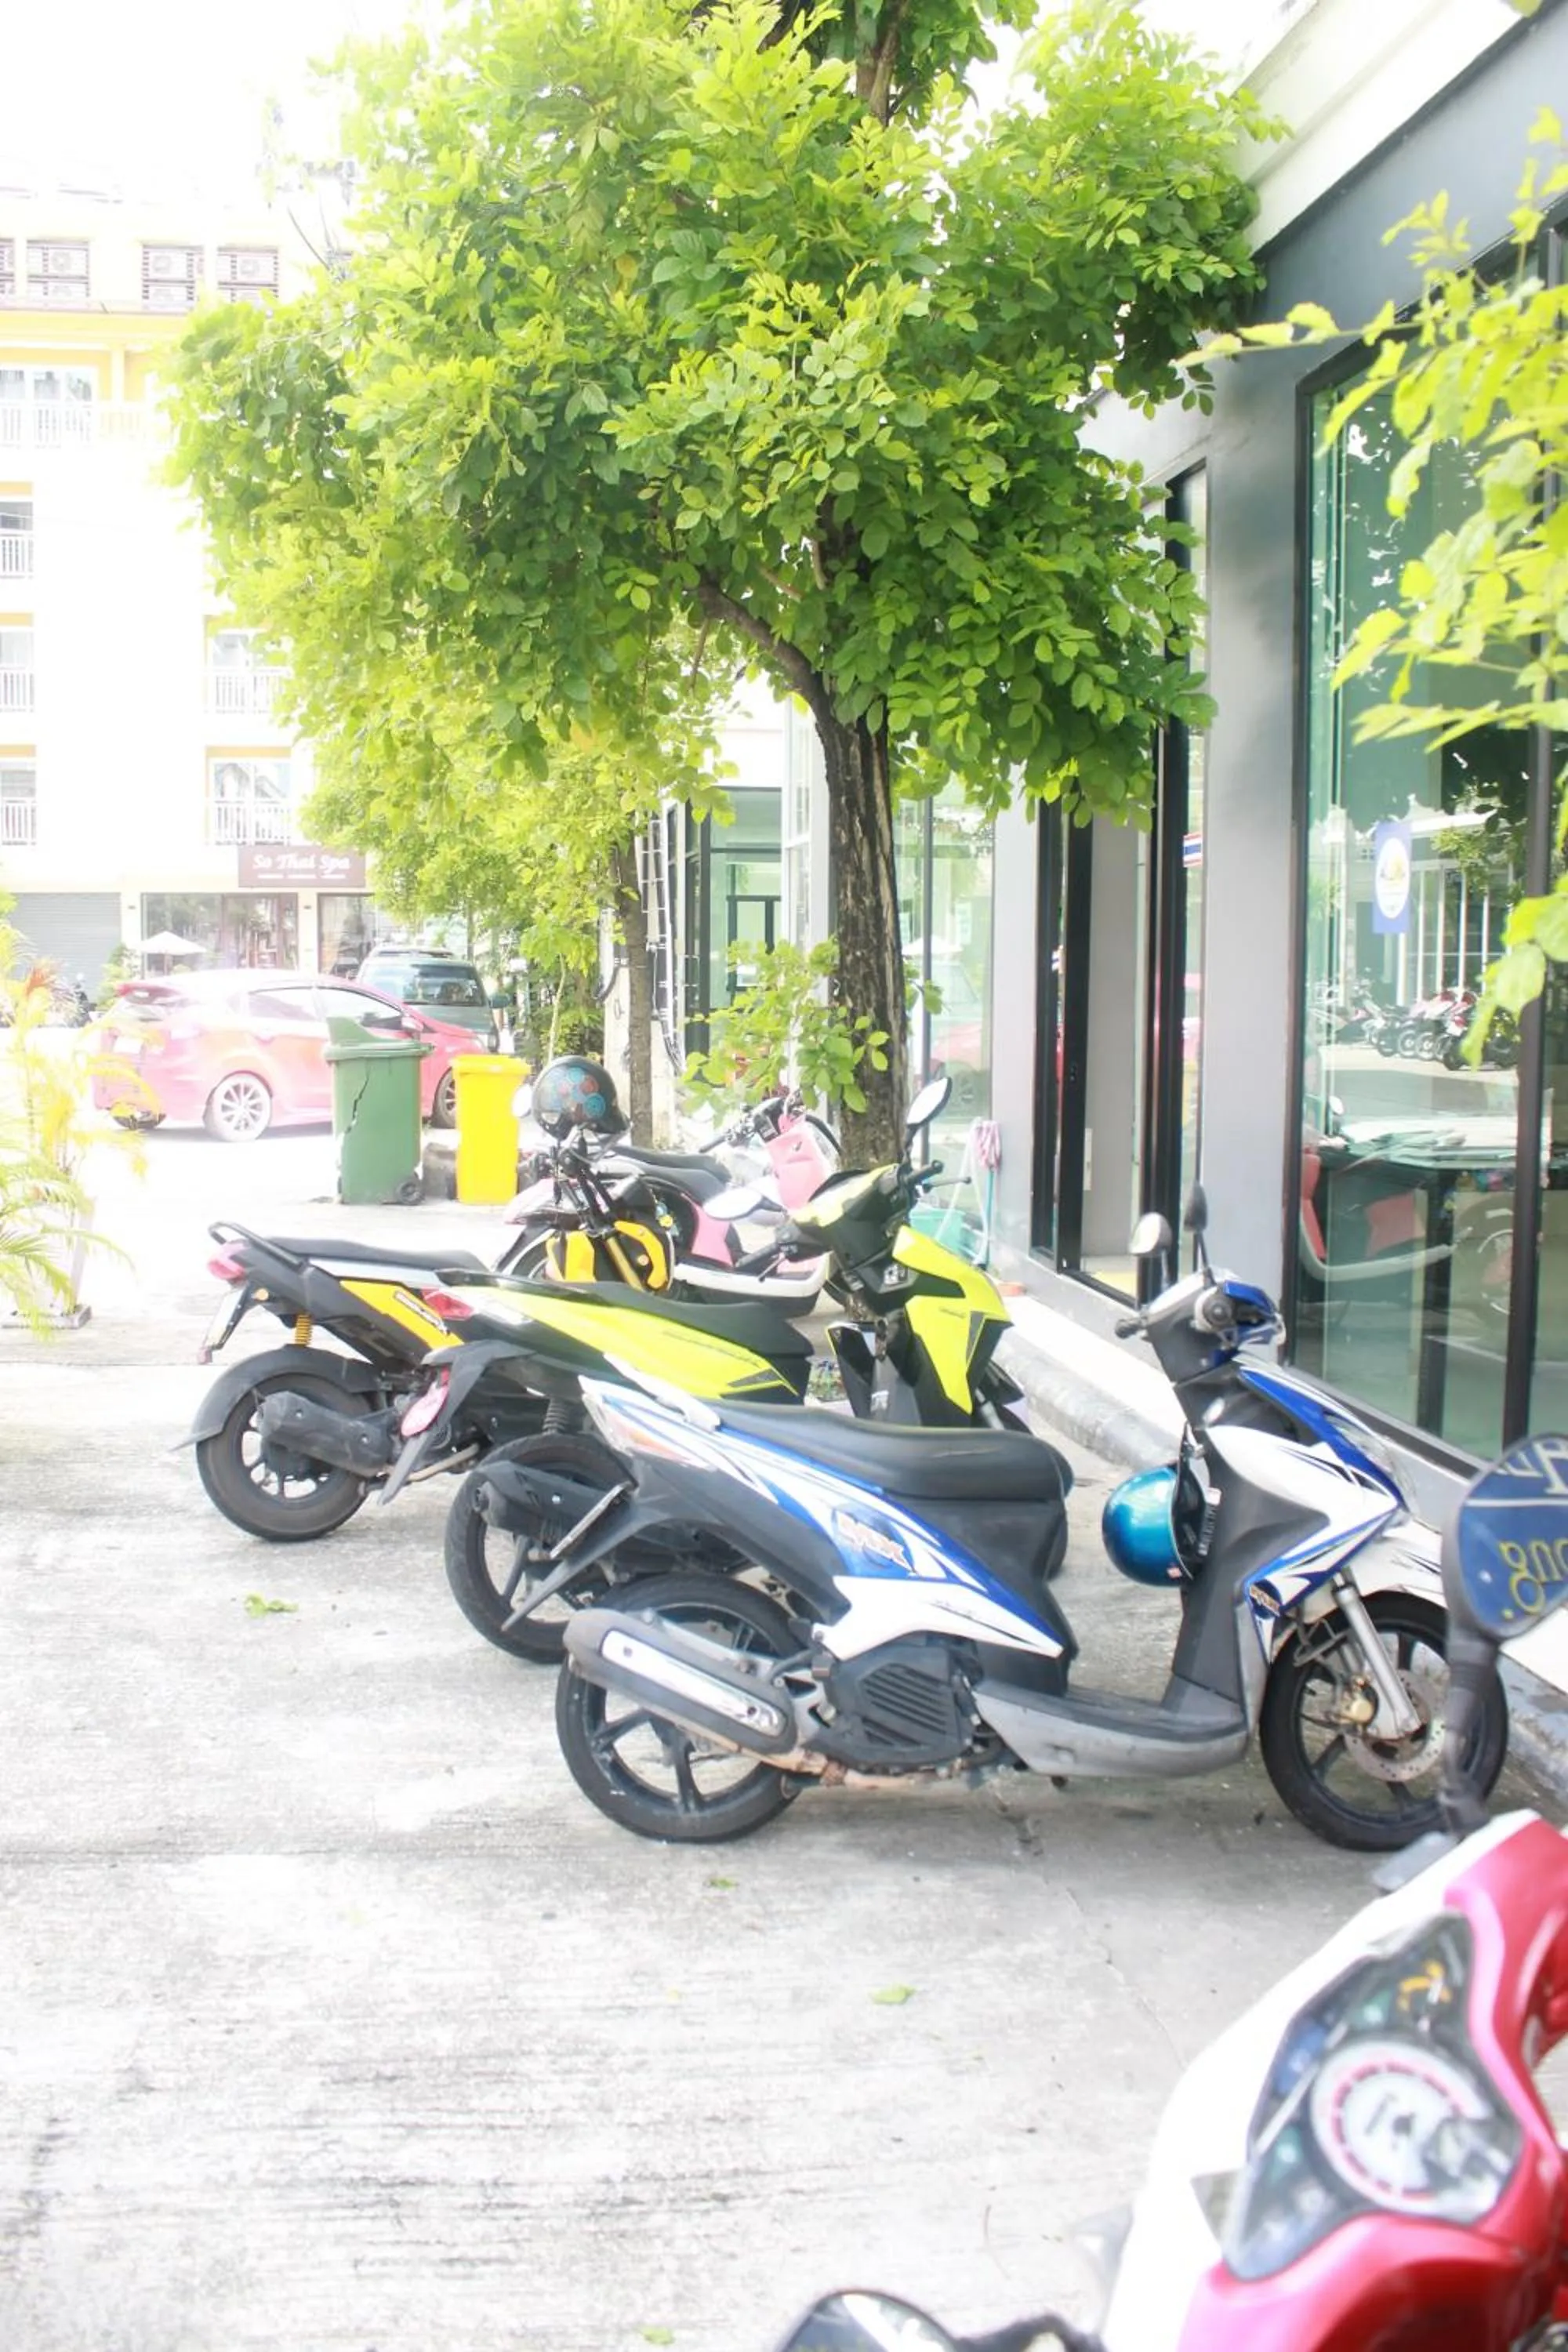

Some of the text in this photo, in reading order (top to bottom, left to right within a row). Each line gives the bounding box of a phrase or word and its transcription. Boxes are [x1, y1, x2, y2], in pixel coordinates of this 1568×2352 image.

[252, 852, 350, 875] So Thai Spa
